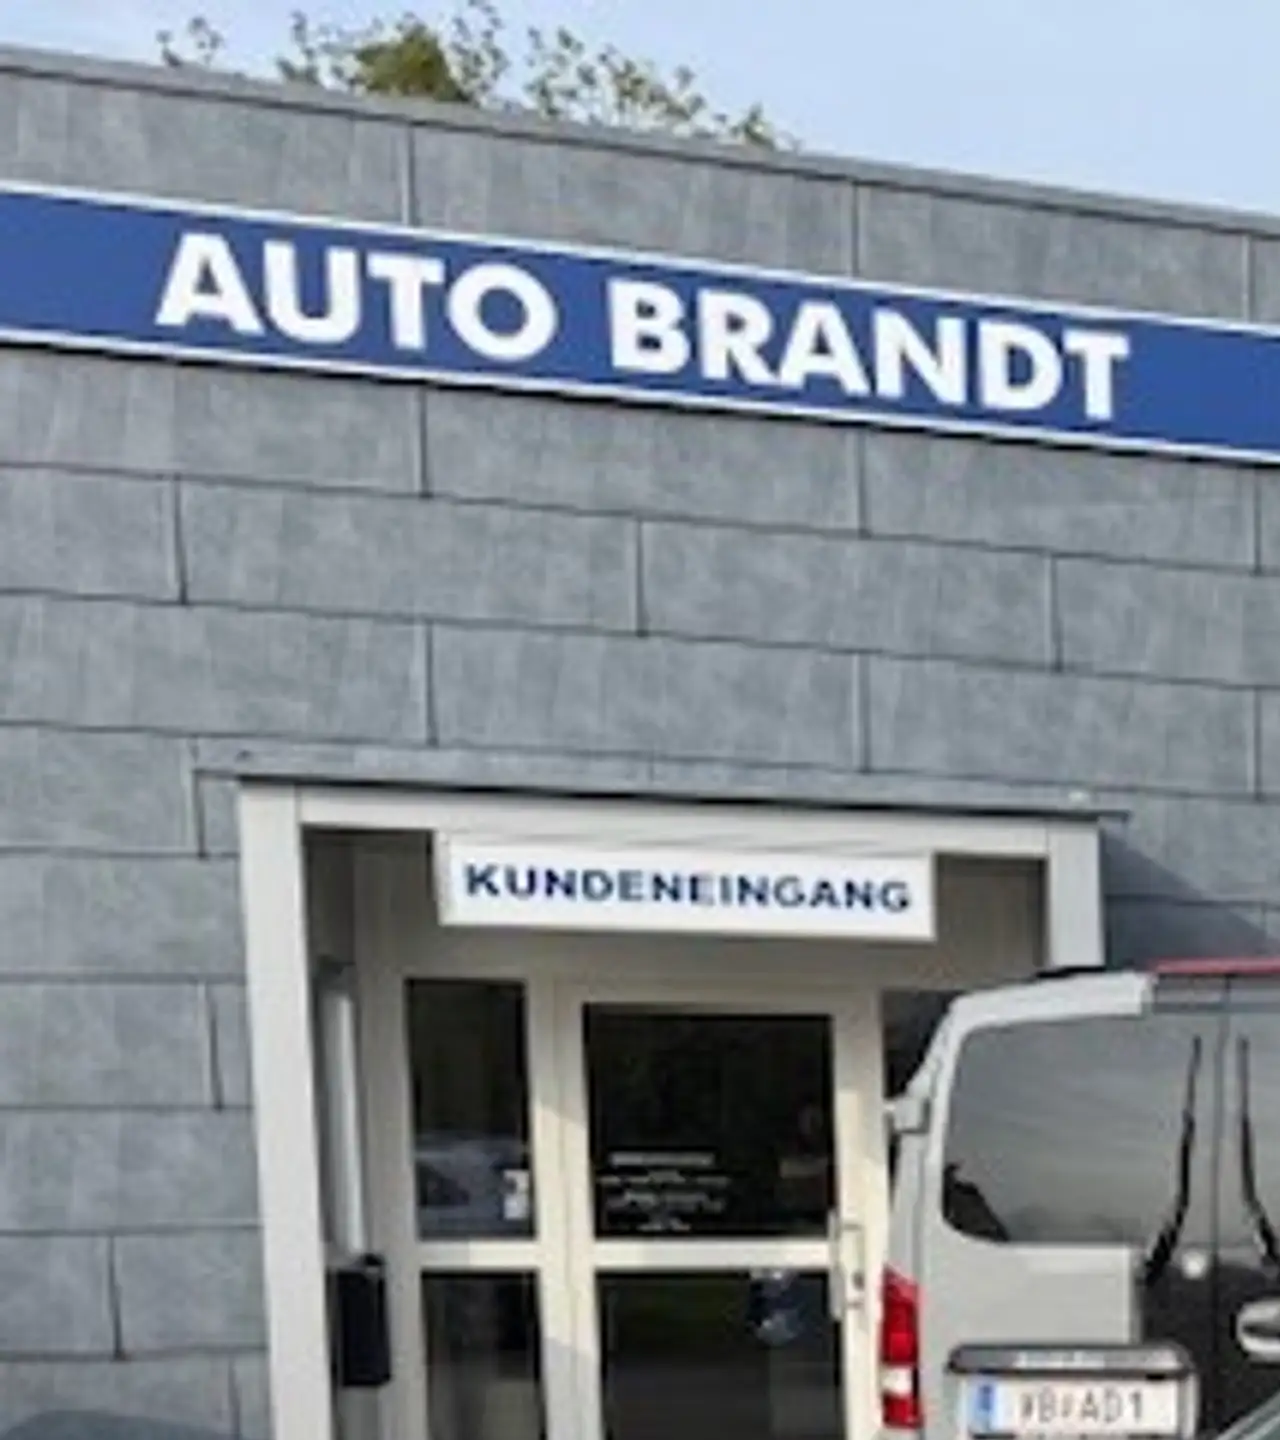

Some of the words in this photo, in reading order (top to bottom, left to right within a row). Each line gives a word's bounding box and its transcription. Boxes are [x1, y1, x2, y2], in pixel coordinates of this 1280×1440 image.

[154, 231, 558, 362] AUTO
[607, 277, 1131, 421] BRANDT
[465, 864, 911, 912] KUNDENEINGANG
